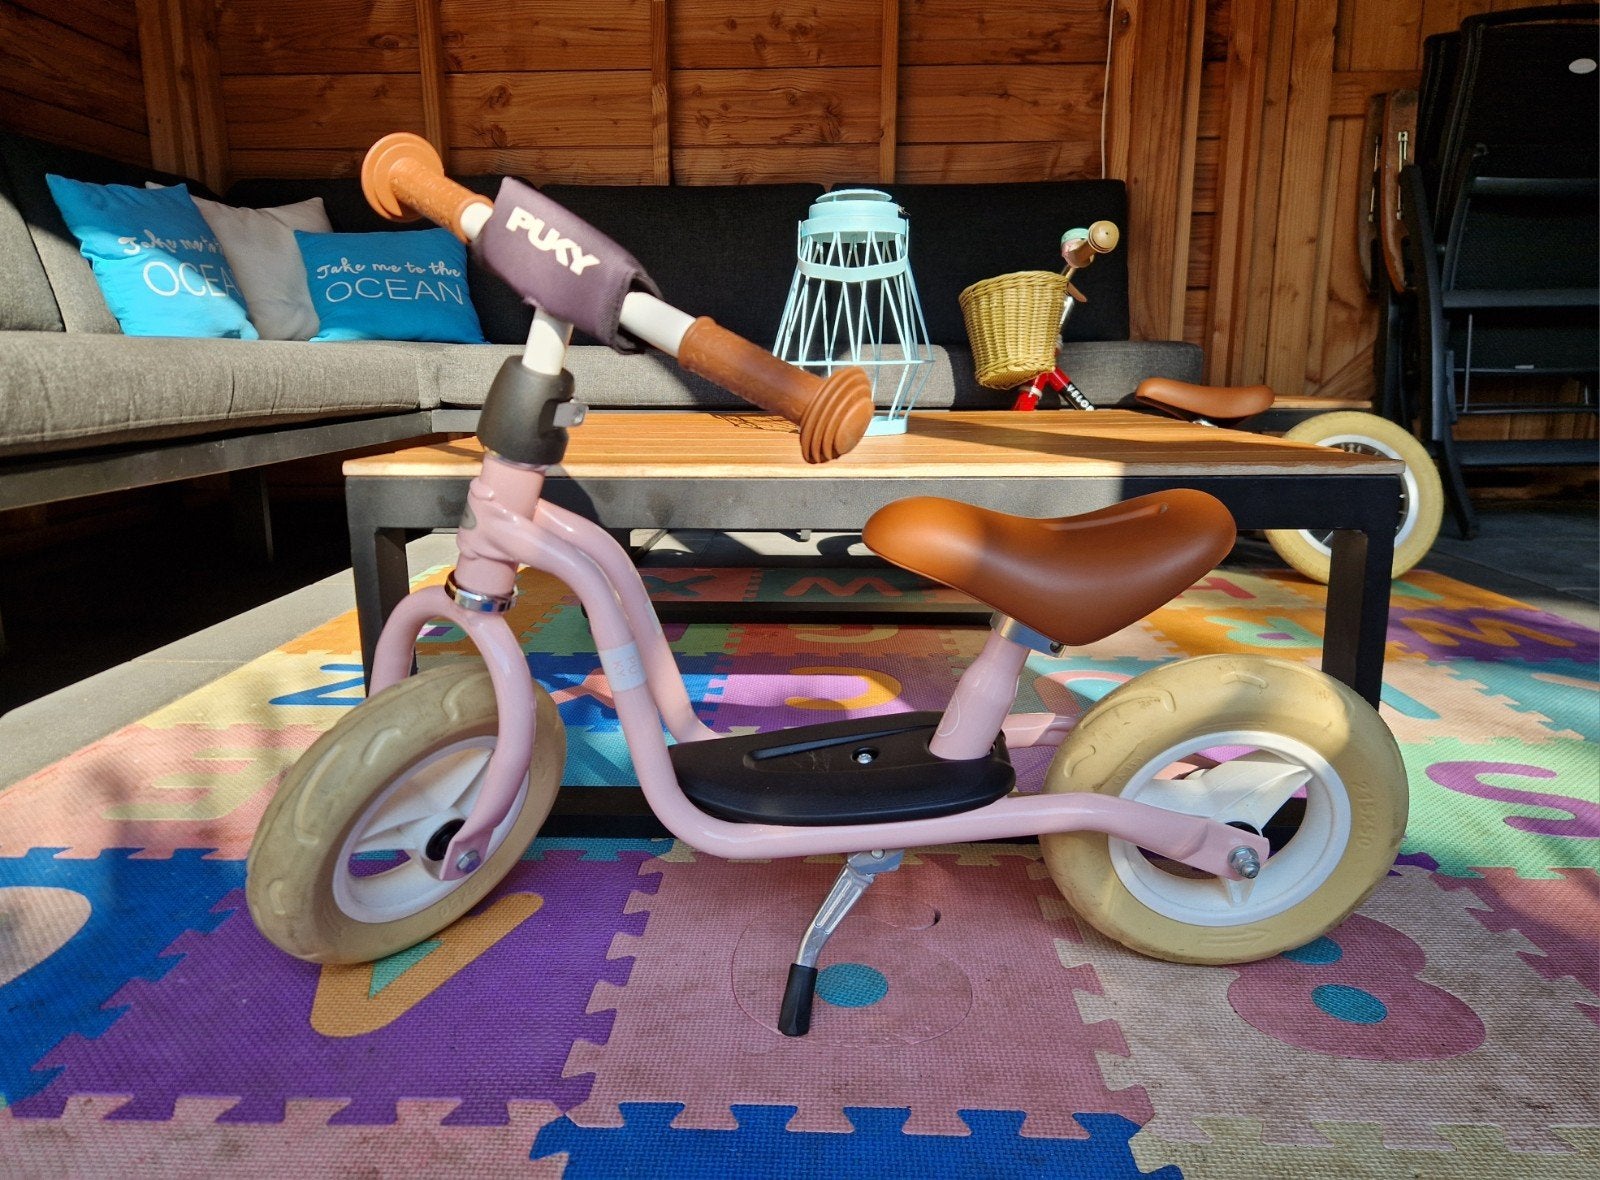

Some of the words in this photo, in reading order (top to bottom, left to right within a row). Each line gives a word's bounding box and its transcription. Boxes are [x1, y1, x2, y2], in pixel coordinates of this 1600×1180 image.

[505, 206, 601, 276] PUKY
[316, 257, 366, 279] Take
[372, 262, 401, 273] me
[404, 261, 426, 274] to
[428, 260, 461, 277] the
[325, 277, 464, 306] OCEAN
